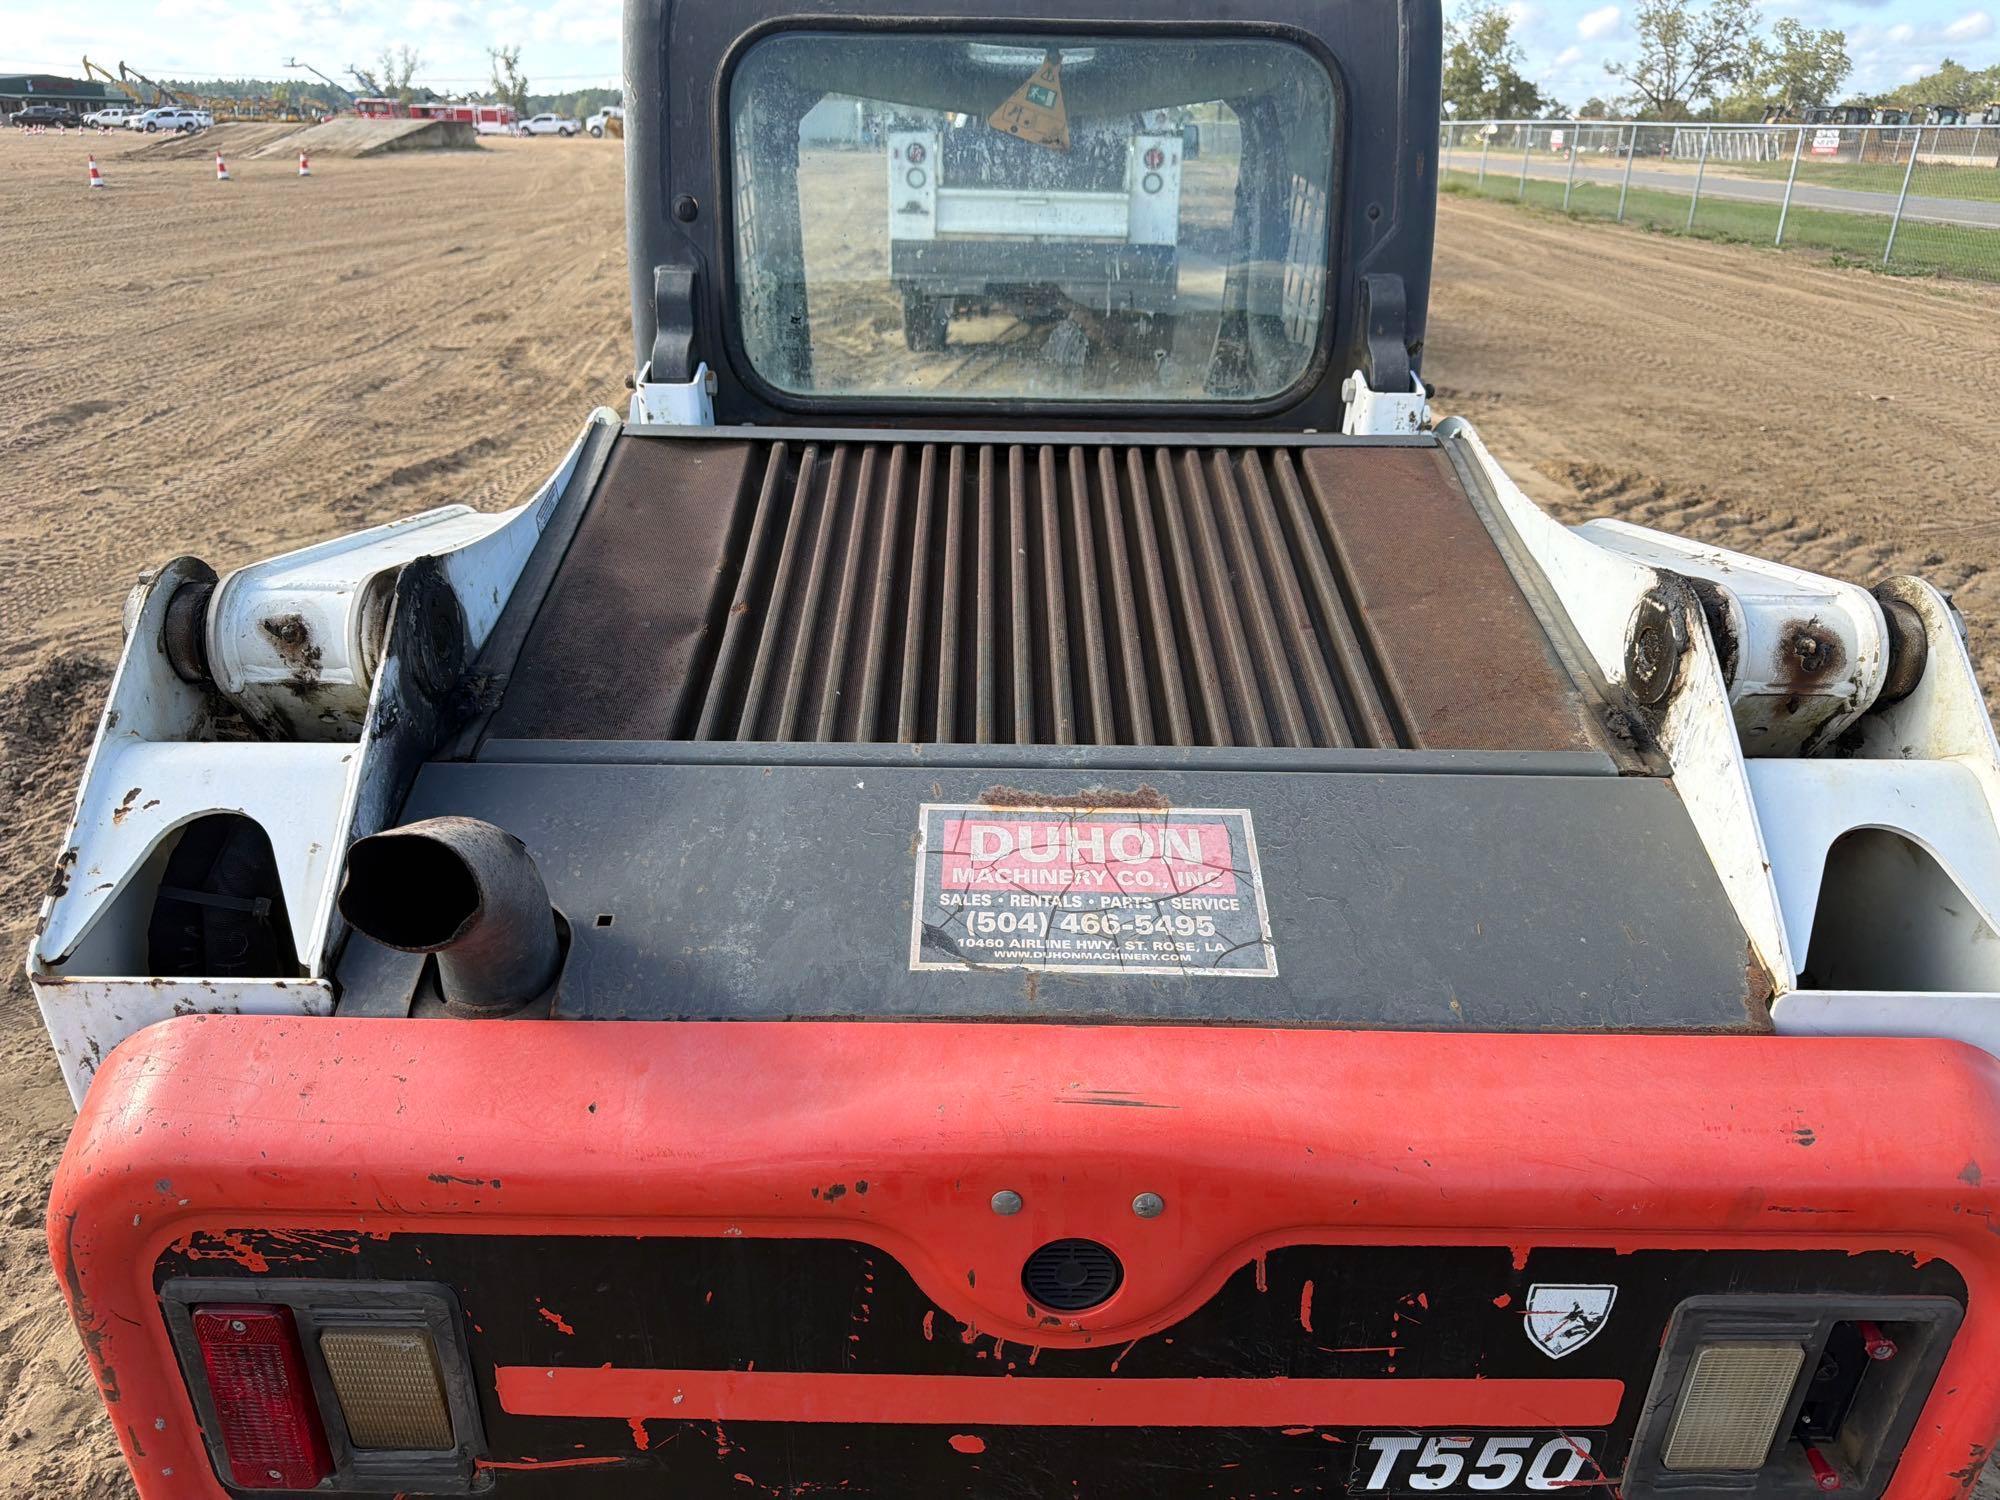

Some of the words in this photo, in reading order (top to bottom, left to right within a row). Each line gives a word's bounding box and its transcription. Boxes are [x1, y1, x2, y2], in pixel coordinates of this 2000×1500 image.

[970, 825, 1204, 865] DUHON
[952, 867, 1108, 886] MACHINERY
[1116, 870, 1169, 889] CO.,
[1177, 871, 1225, 888] INC
[940, 893, 992, 907] SALES
[1009, 894, 1083, 908] RENTALS
[1100, 896, 1154, 909] PARTS
[1171, 898, 1240, 911] SERVICE
[966, 910, 1049, 938] (504)
[1060, 911, 1216, 937] 466-5495
[958, 938, 1004, 948] 10460
[1009, 938, 1071, 950] AIRLINE
[1124, 941, 1148, 951] ST.
[1152, 942, 1200, 953] ROSE,
[1204, 943, 1226, 953] LA
[994, 950, 1192, 962] WWW.DUHONMACHINERY.COM
[1366, 1437, 1592, 1490] T550
